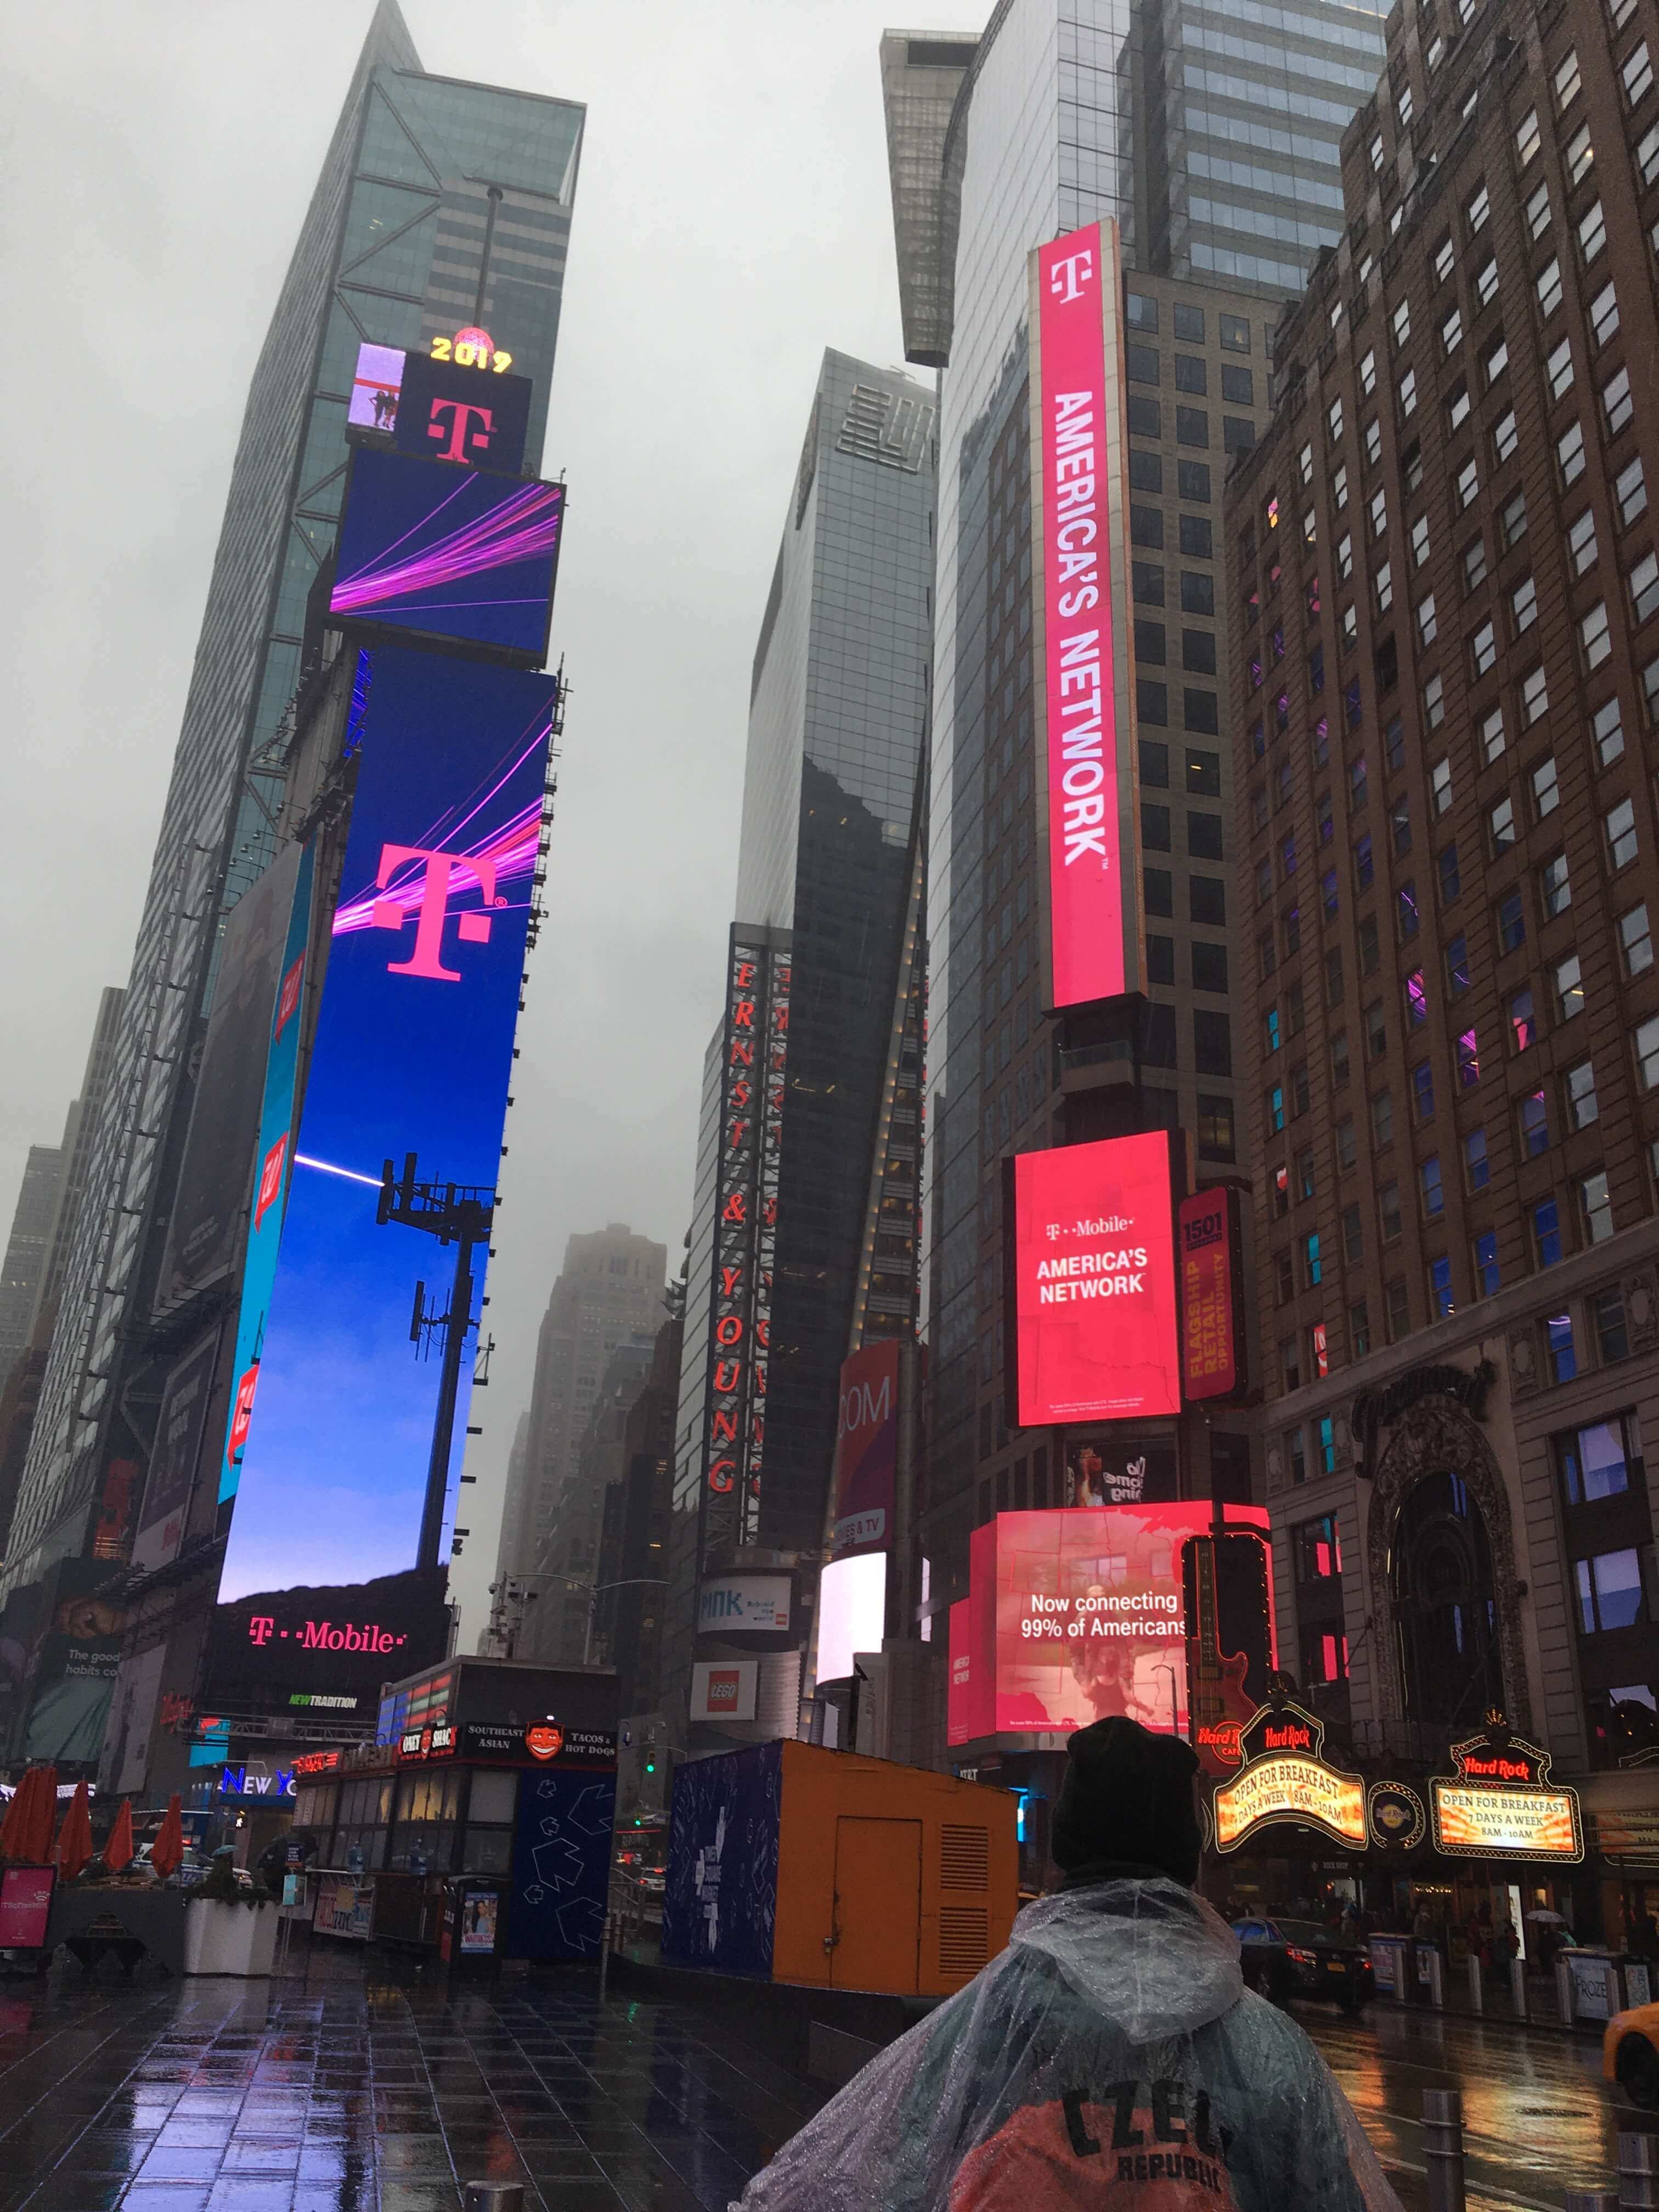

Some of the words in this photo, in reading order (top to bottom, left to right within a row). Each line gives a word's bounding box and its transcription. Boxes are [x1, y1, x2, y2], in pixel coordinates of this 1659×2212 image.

[431, 337, 512, 373] 2019
[1055, 390, 1099, 618] AMERICA'S
[730, 963, 755, 1148] ERNST
[723, 1194, 747, 1221] &
[1183, 1211, 1222, 1242] 1501
[1036, 1247, 1148, 1280] AMERICA'S
[1187, 1260, 1204, 1379] FLAGSHIP
[1214, 1254, 1228, 1370] OPPORTUNITY
[1202, 1290, 1217, 1374] RETAIL
[710, 1268, 743, 1493] YOUNG
[866, 1517, 879, 1532] TV
[1031, 1594, 1069, 1612] Now
[1075, 1591, 1177, 1613] connecting
[1022, 1619, 1062, 1638] 99%
[1068, 1618, 1086, 1637] of
[69, 1649, 88, 1660] The
[91, 1651, 121, 1663] good
[65, 1663, 100, 1677] habits
[711, 1683, 737, 1699] LEGO
[469, 1725, 525, 1737] SOUTHEAST
[571, 1733, 604, 1743] TACOS
[1199, 1728, 1231, 1745] Hard
[1266, 1725, 1288, 1748] Hard
[1288, 1723, 1310, 1750] Rock
[478, 1738, 511, 1749] ASIAN
[565, 1744, 585, 1753] HOT
[589, 1745, 616, 1757] DOGS
[1465, 1757, 1497, 1775] Hard
[1499, 1760, 1530, 1781] Rock
[1234, 1775, 1257, 1805] OPEN
[1260, 1767, 1277, 1785] FOR
[1279, 1765, 1338, 1800] BREAKFAST
[1238, 1801, 1256, 1824] DAYS
[1257, 1797, 1263, 1807] A
[1263, 1790, 1286, 1805] WEEK
[1294, 1789, 1313, 1808] 8AM
[1318, 1801, 1343, 1825] 10AM
[1443, 1794, 1473, 1807] OPEN
[1476, 1797, 1499, 1809] FOR
[1501, 1799, 1566, 1813] BREAKFAST
[1468, 1814, 1474, 1824] 7
[1476, 1812, 1503, 1824] DAYS
[1505, 1815, 1513, 1823] A
[1515, 1815, 1544, 1826] WEEK
[1481, 1826, 1502, 1837] 8AM
[1509, 1830, 1533, 1839] 10AM
